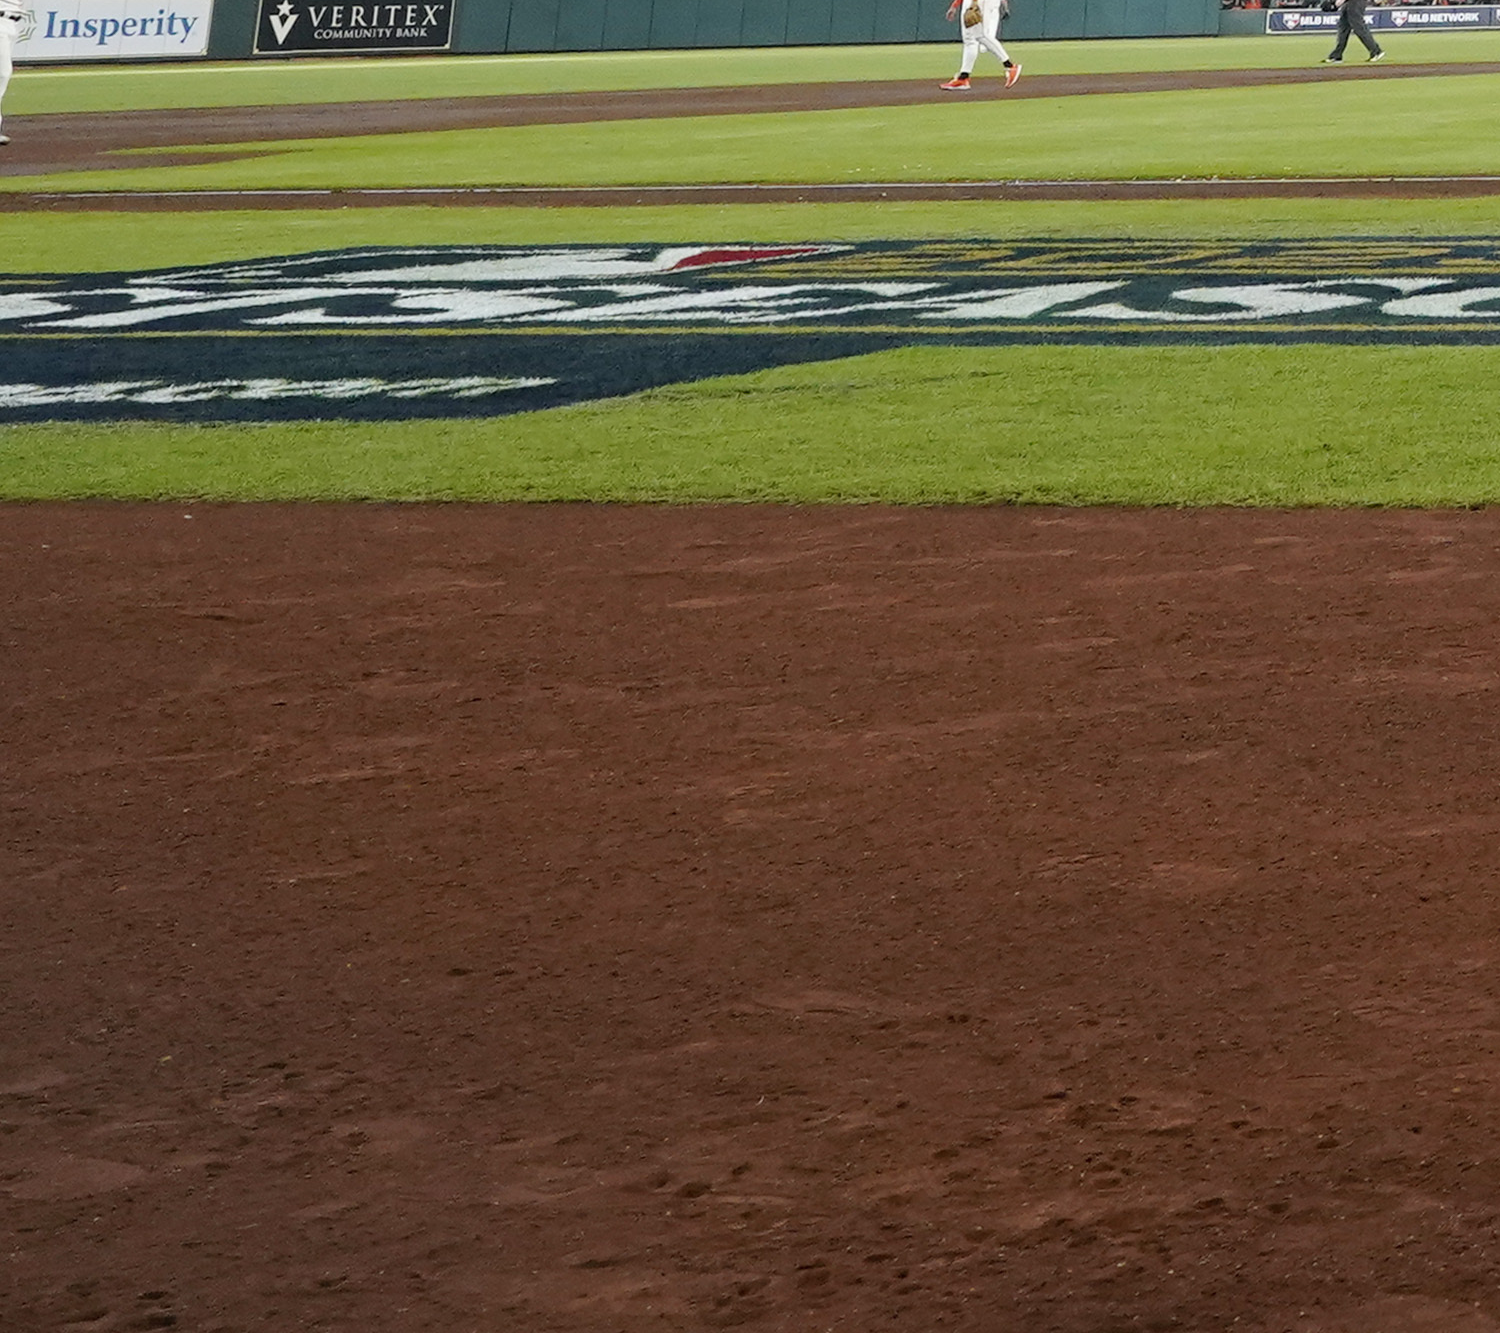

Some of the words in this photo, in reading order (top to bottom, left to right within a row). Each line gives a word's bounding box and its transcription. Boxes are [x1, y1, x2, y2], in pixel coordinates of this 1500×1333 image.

[308, 4, 440, 28] VERITEX
[1408, 13, 1429, 23] MLB
[1430, 12, 1480, 24] NETWORK
[44, 8, 198, 45] Insperity
[314, 28, 393, 40] COMMUNITY
[396, 27, 429, 38] BANK
